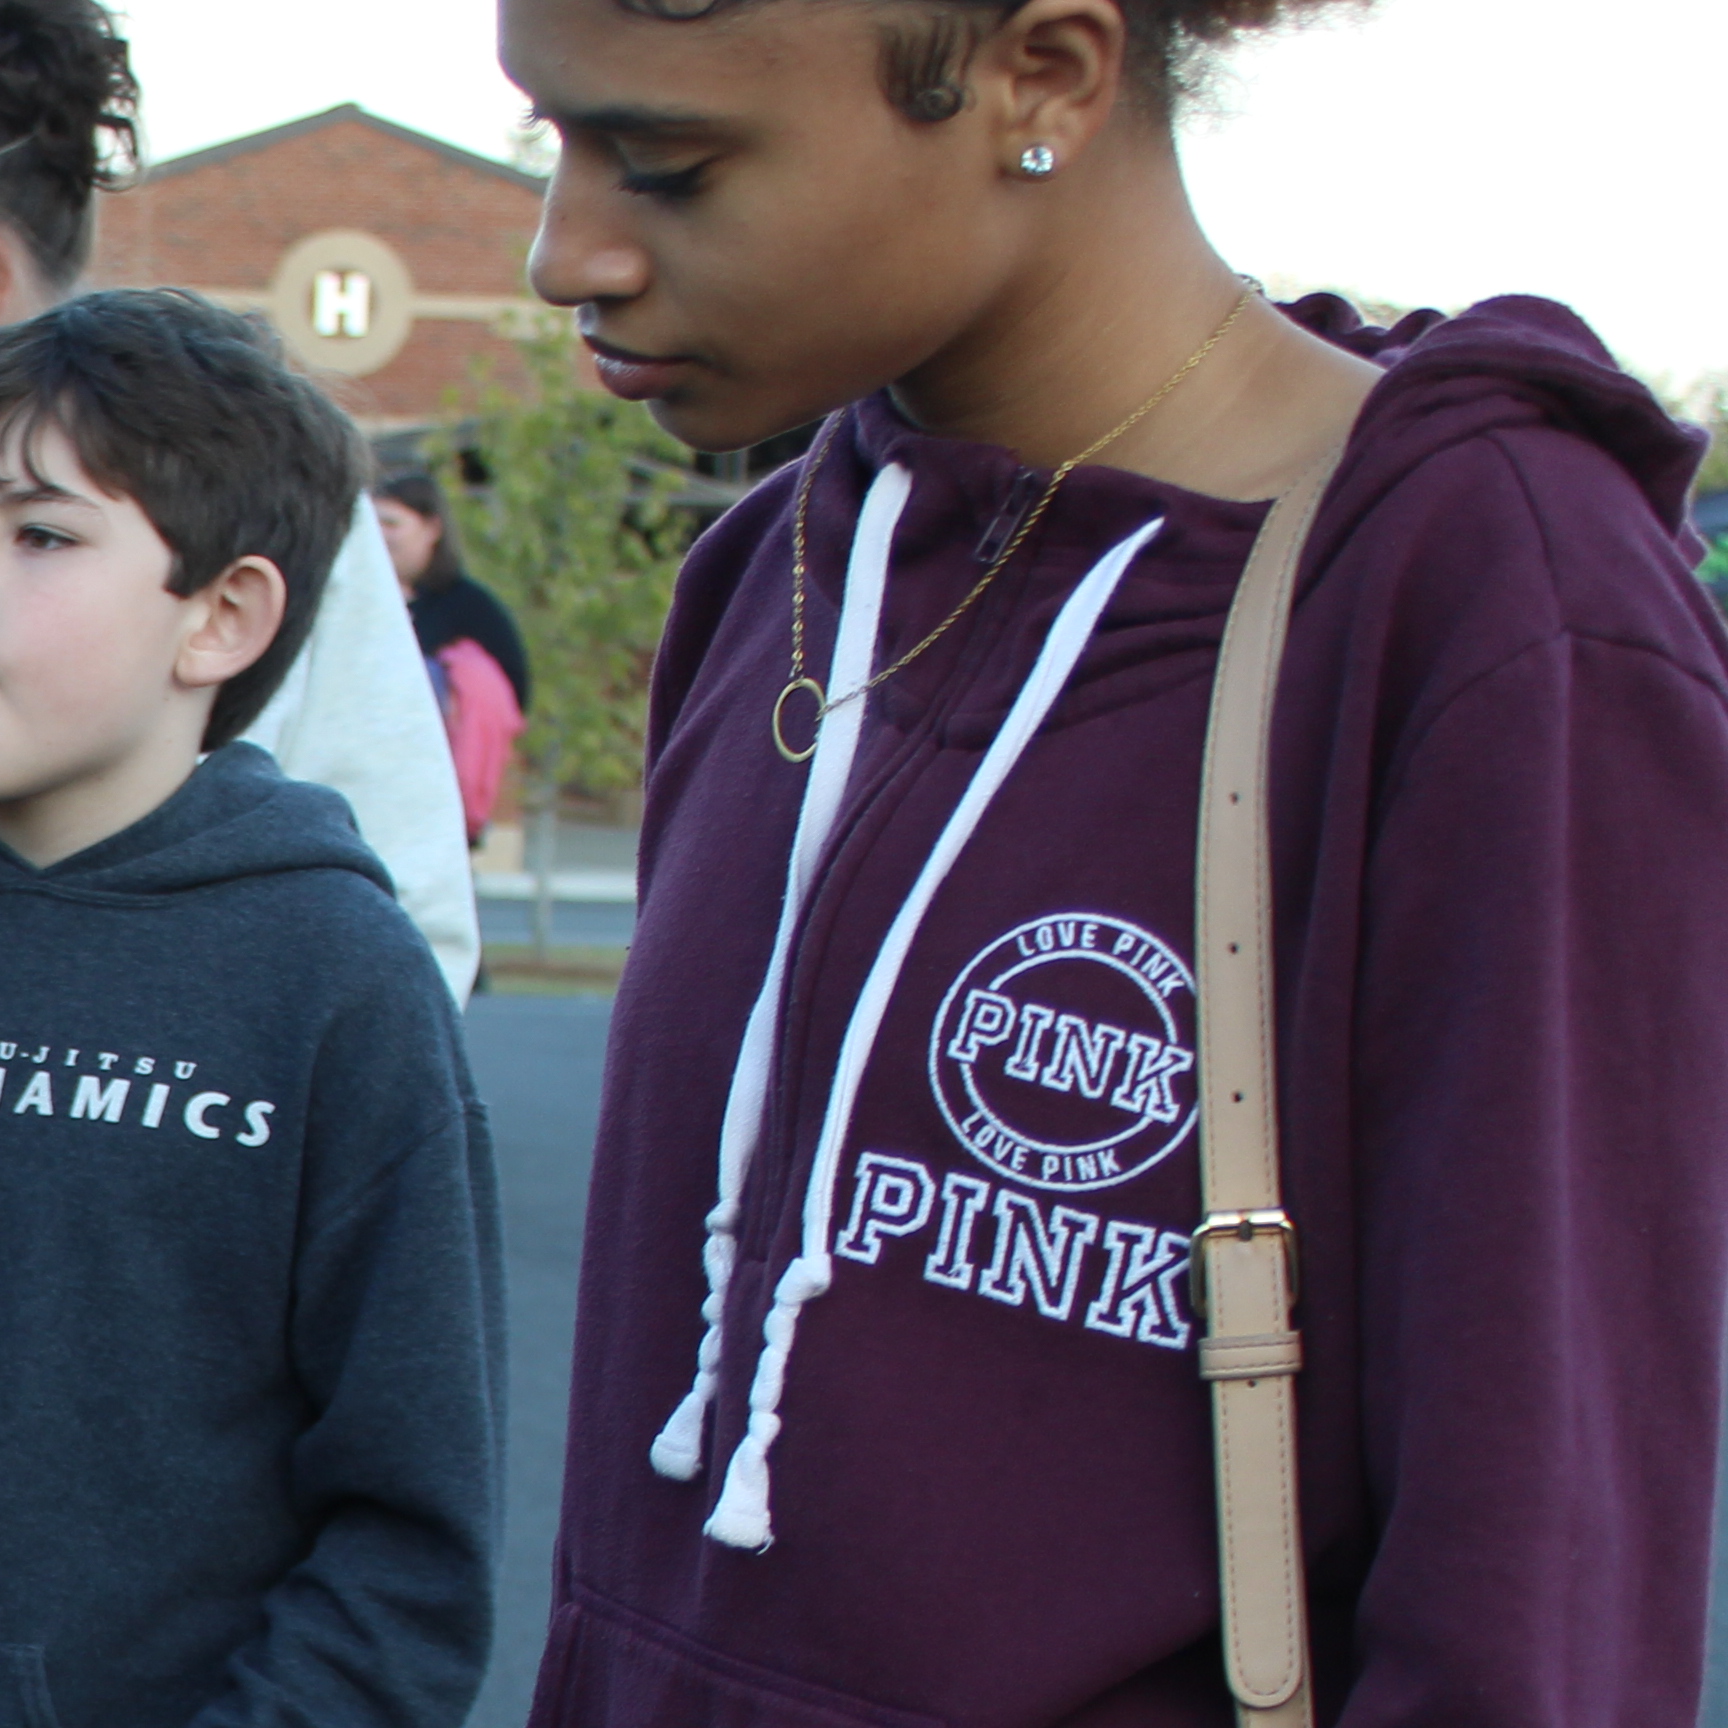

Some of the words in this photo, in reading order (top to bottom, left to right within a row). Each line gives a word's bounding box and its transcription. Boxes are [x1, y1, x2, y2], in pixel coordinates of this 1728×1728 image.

[313, 272, 370, 337] H
[1016, 921, 1099, 957] LOVE
[1112, 934, 1185, 999] PINK
[946, 988, 1196, 1124] PINK
[960, 1112, 1031, 1172] LOVE
[1044, 1149, 1121, 1182] PINK
[835, 1151, 1194, 1350] PINK
